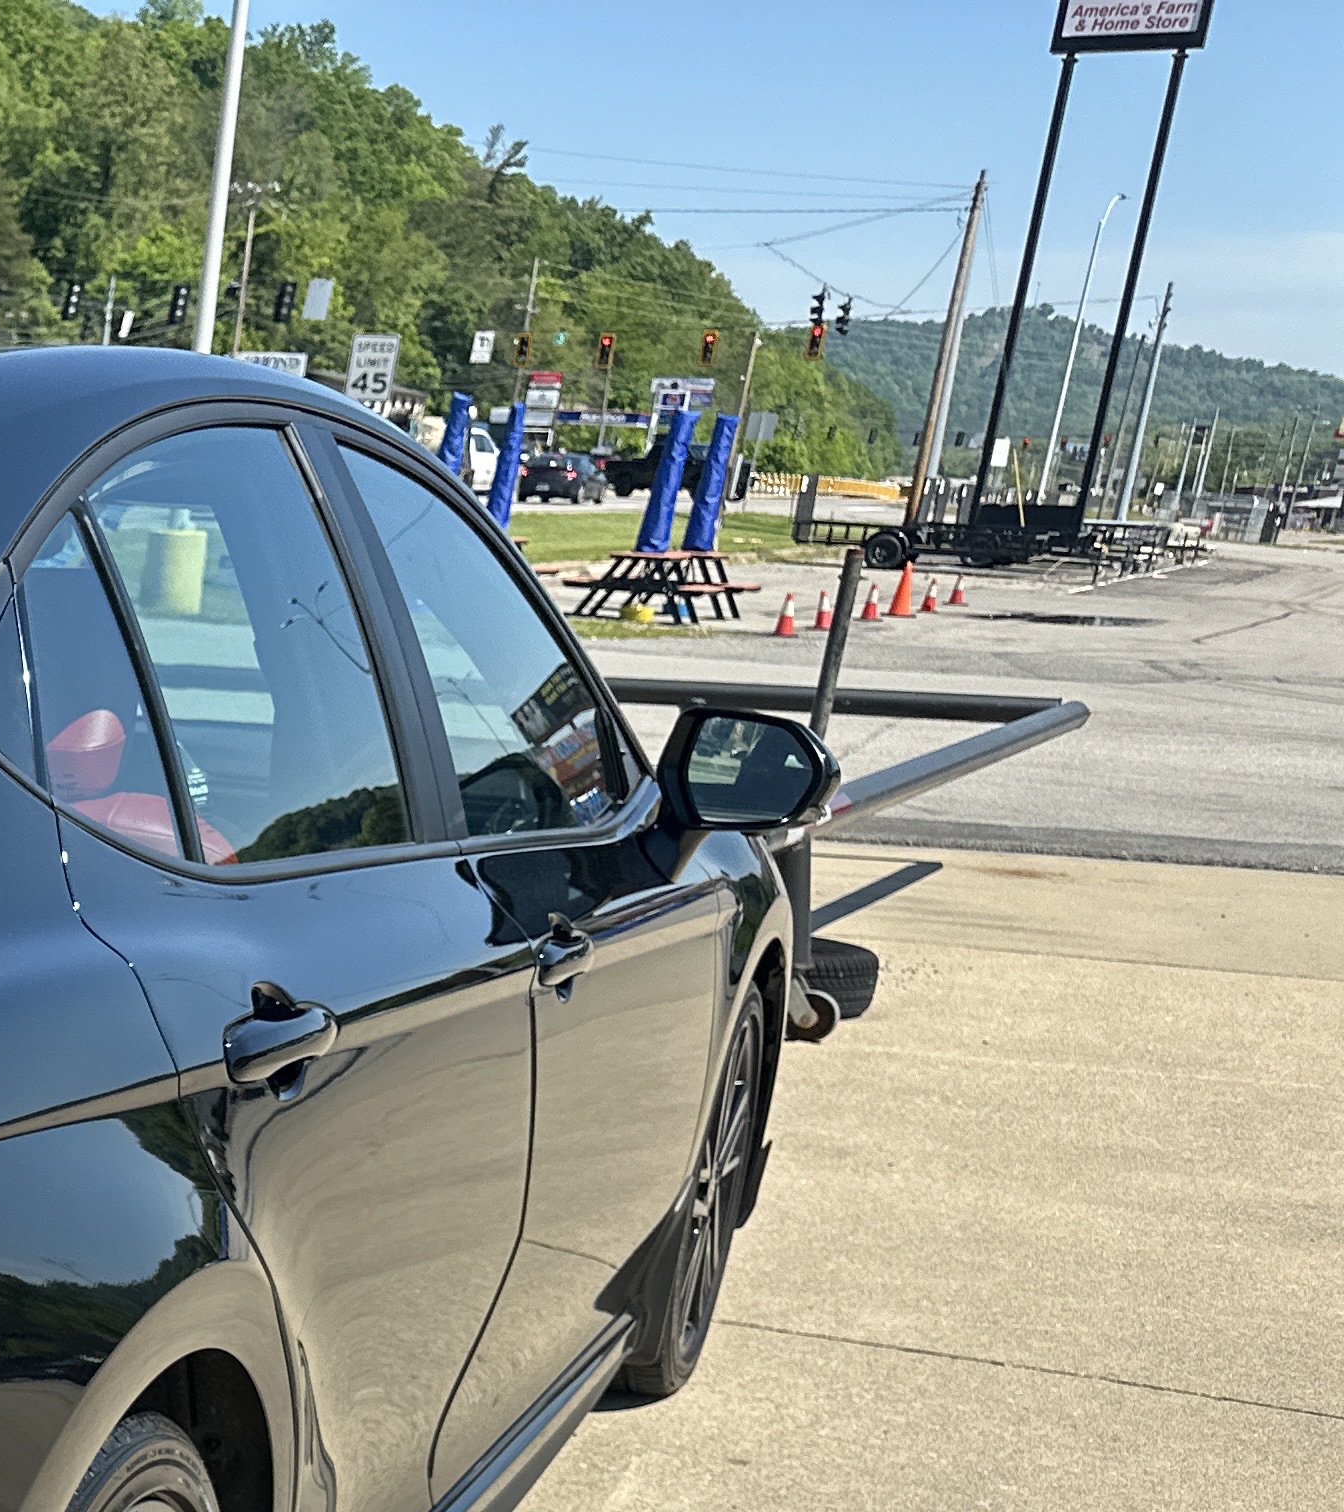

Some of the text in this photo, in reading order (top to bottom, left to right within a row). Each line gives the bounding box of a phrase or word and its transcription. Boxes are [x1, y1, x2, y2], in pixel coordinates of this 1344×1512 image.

[1072, 1, 1198, 18] America's Farm
[1075, 15, 1189, 32] & Home Store
[357, 341, 396, 353] SPEED
[356, 356, 390, 369] LIMIT
[351, 371, 388, 394] 45
